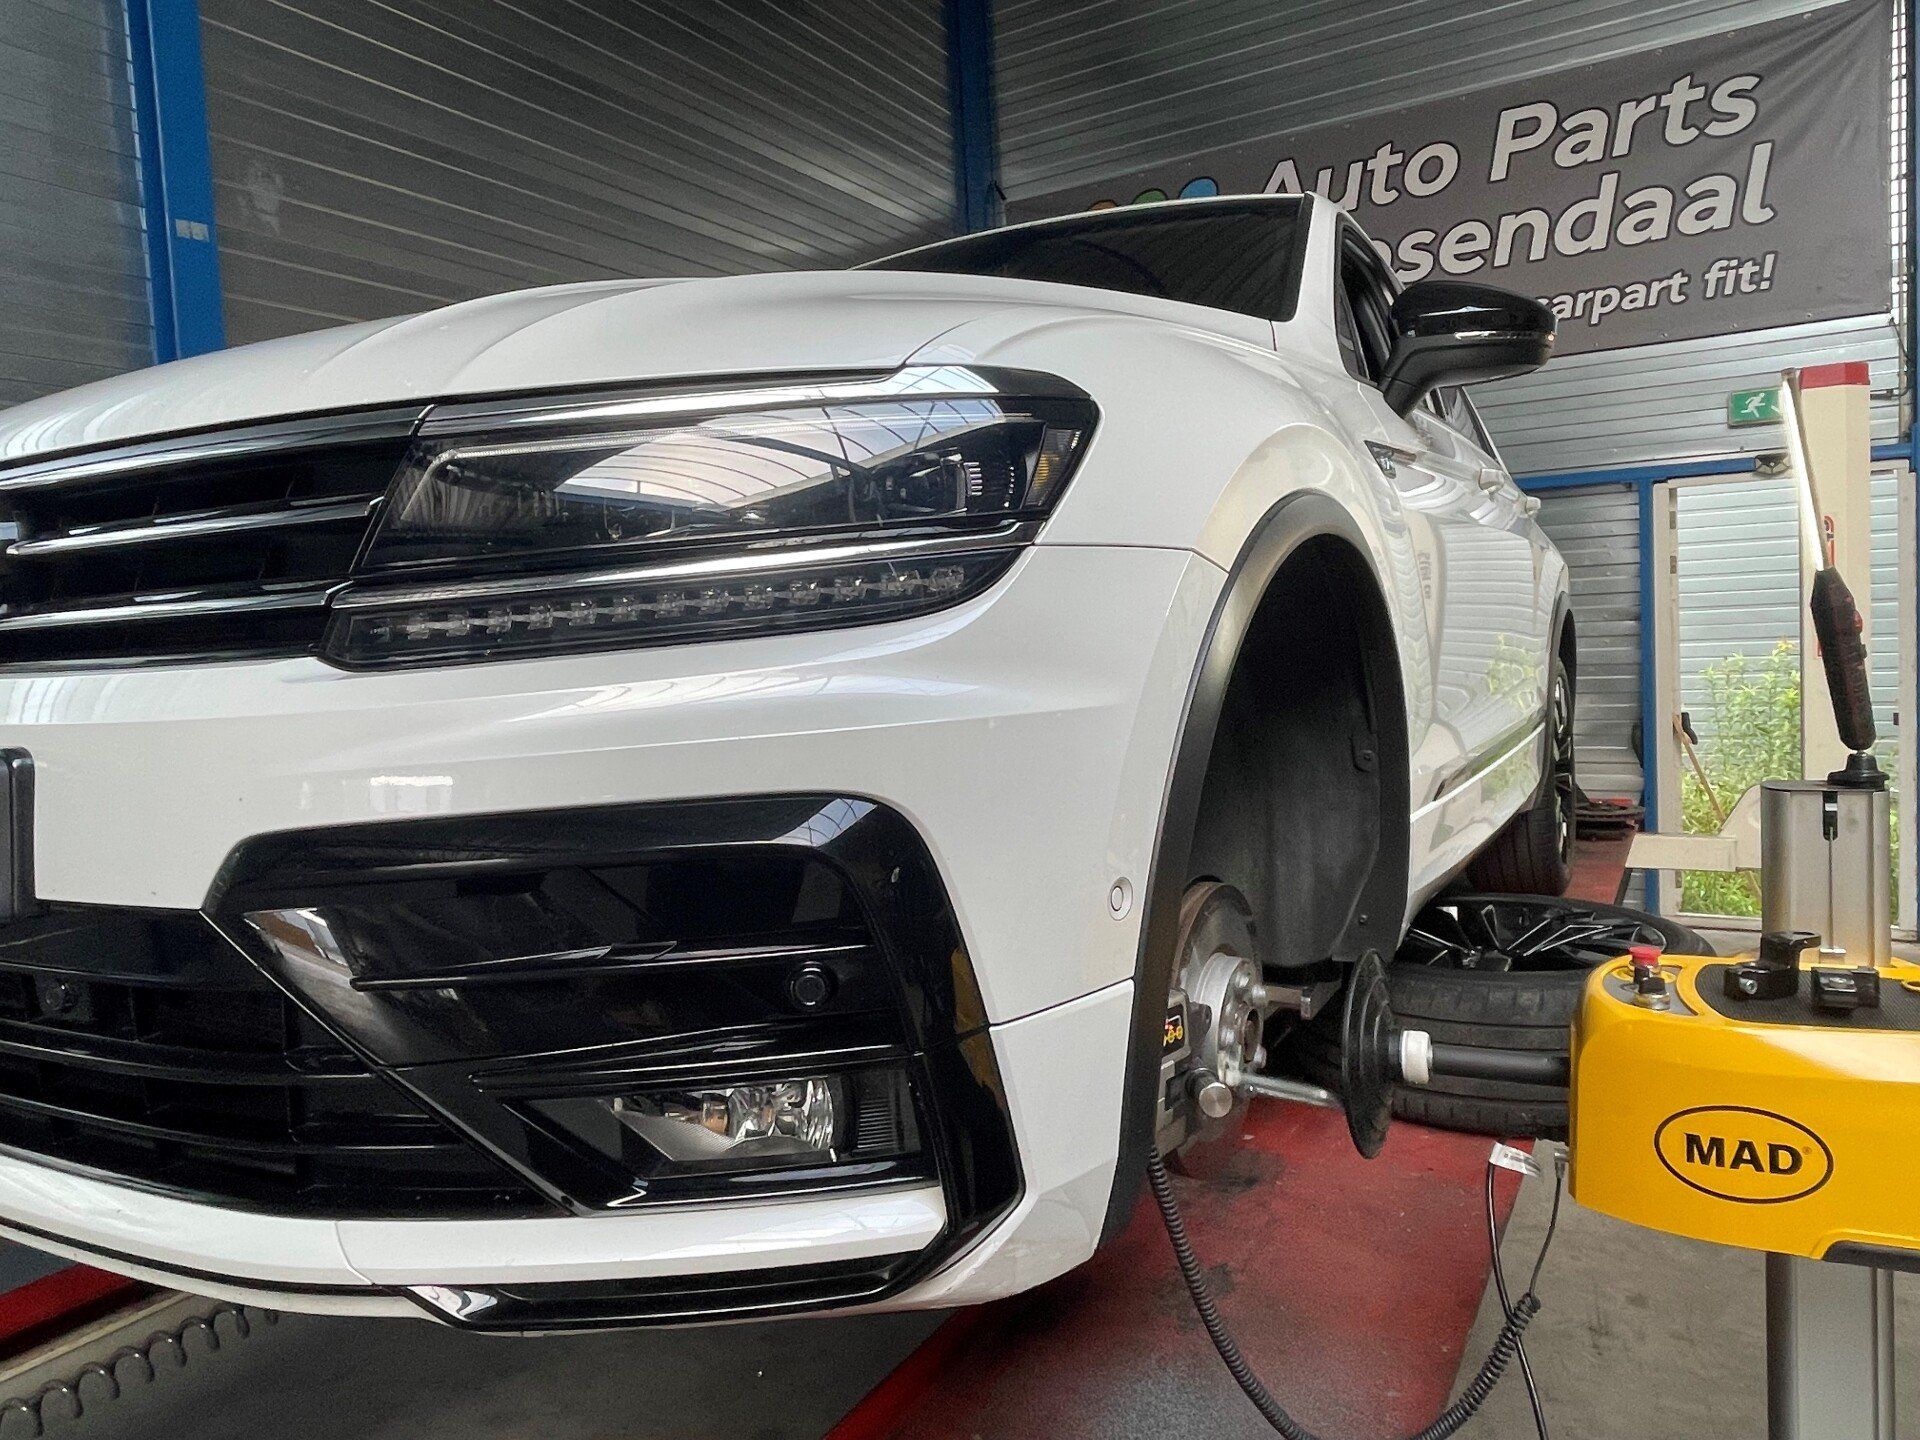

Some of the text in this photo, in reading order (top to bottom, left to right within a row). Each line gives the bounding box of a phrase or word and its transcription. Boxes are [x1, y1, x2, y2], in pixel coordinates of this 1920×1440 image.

[1489, 73, 1762, 182] Parts
[1370, 141, 1776, 283] sendaal
[1536, 252, 1776, 325] arpart fit!
[1684, 1132, 1803, 1176] MAD
